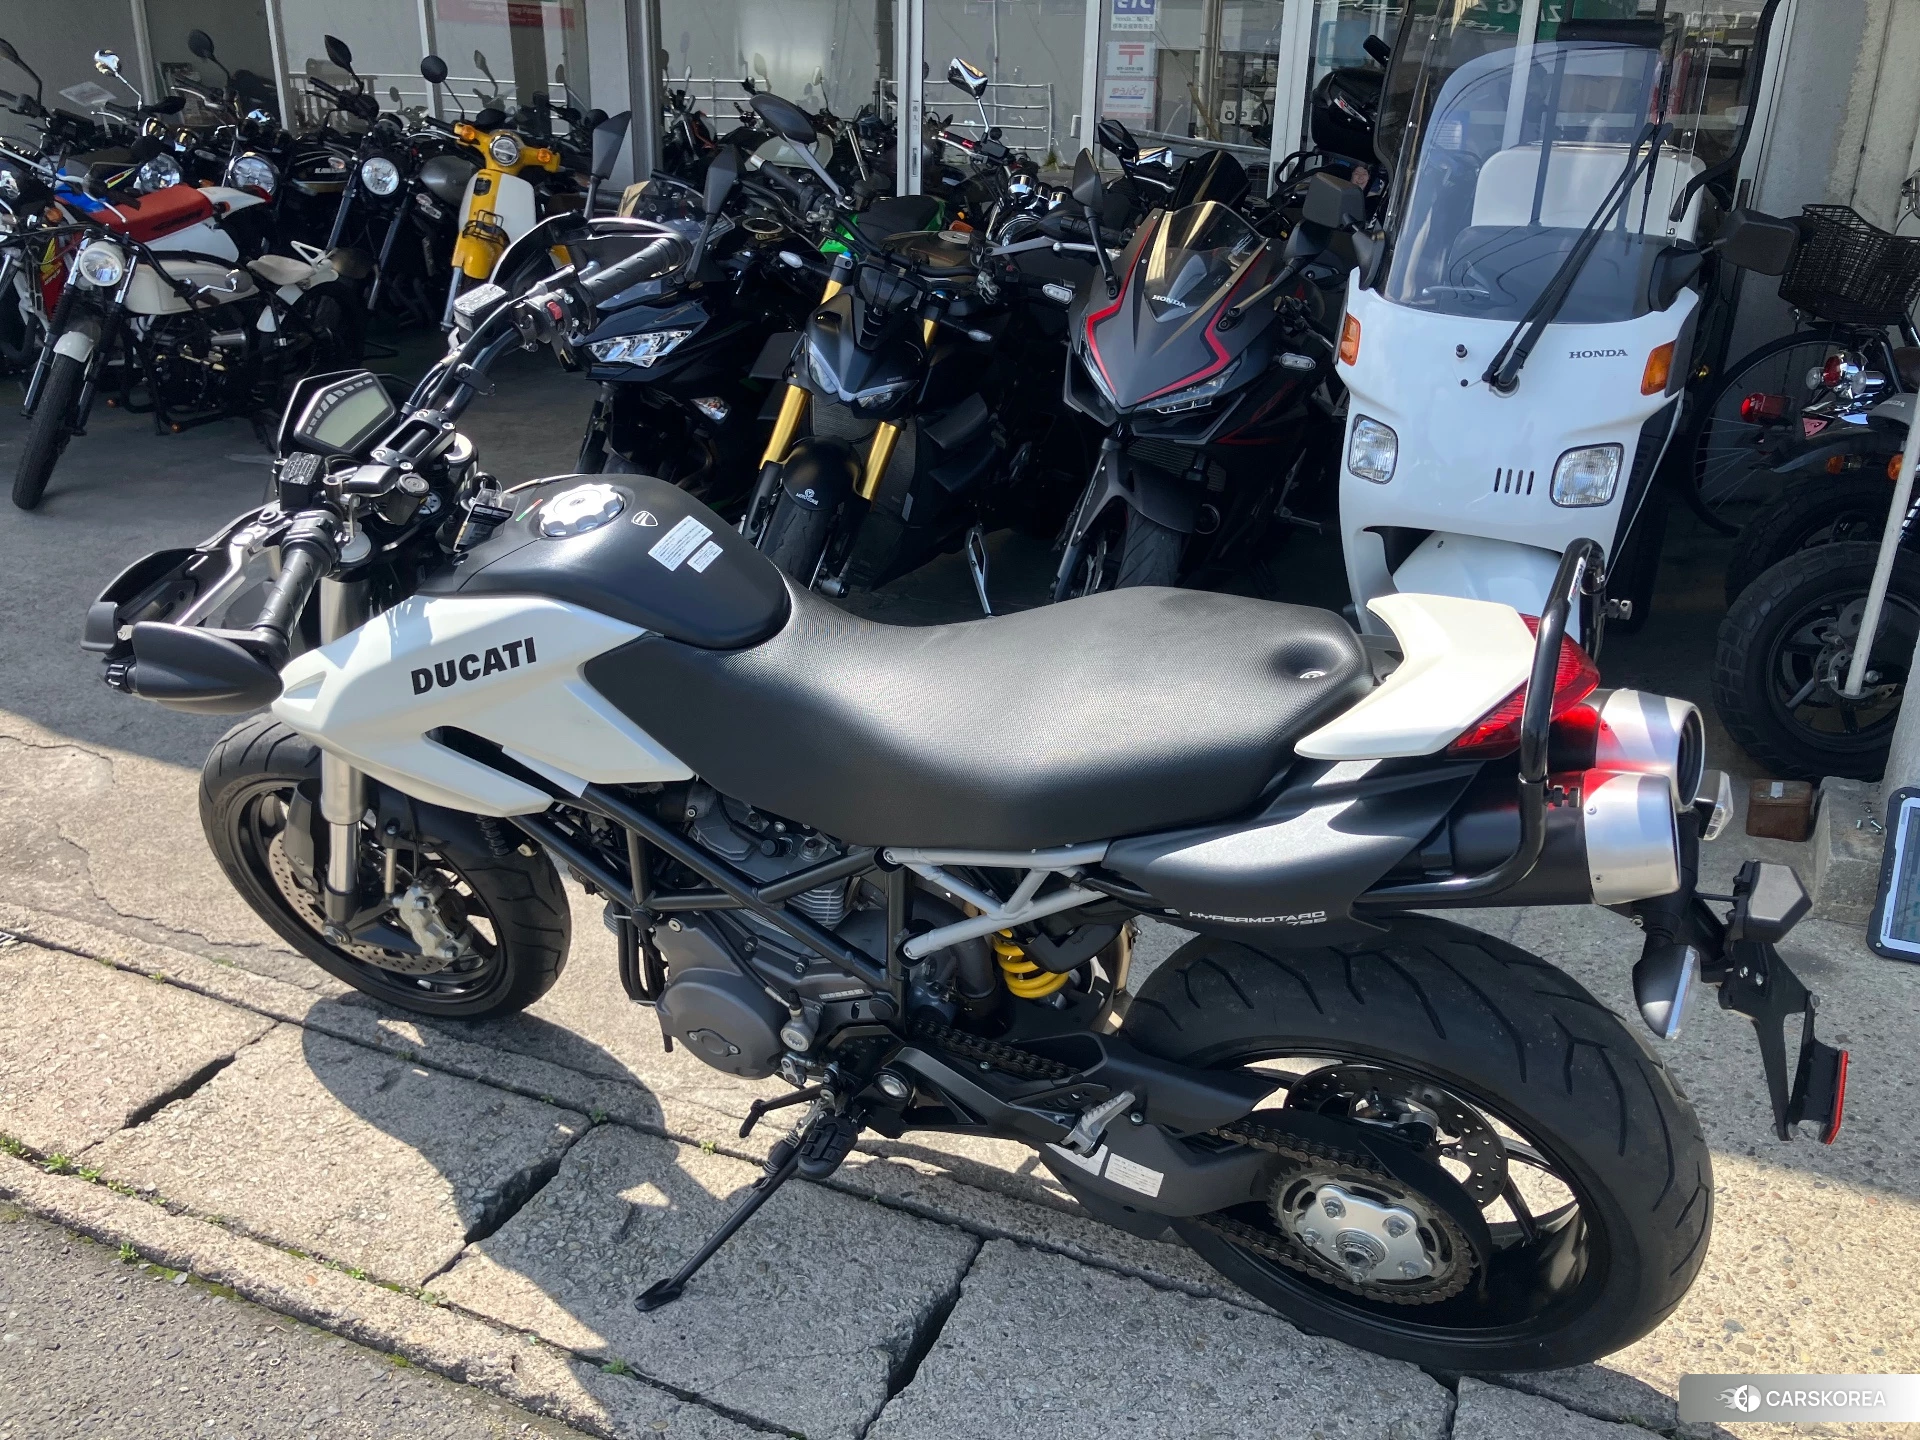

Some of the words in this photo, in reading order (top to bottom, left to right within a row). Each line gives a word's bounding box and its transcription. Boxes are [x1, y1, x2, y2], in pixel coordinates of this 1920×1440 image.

[1151, 294, 1187, 309] HONDA
[1568, 349, 1629, 360] HONDA
[410, 636, 537, 696] DUCATI
[1189, 910, 1326, 924] HYPERMOTARD
